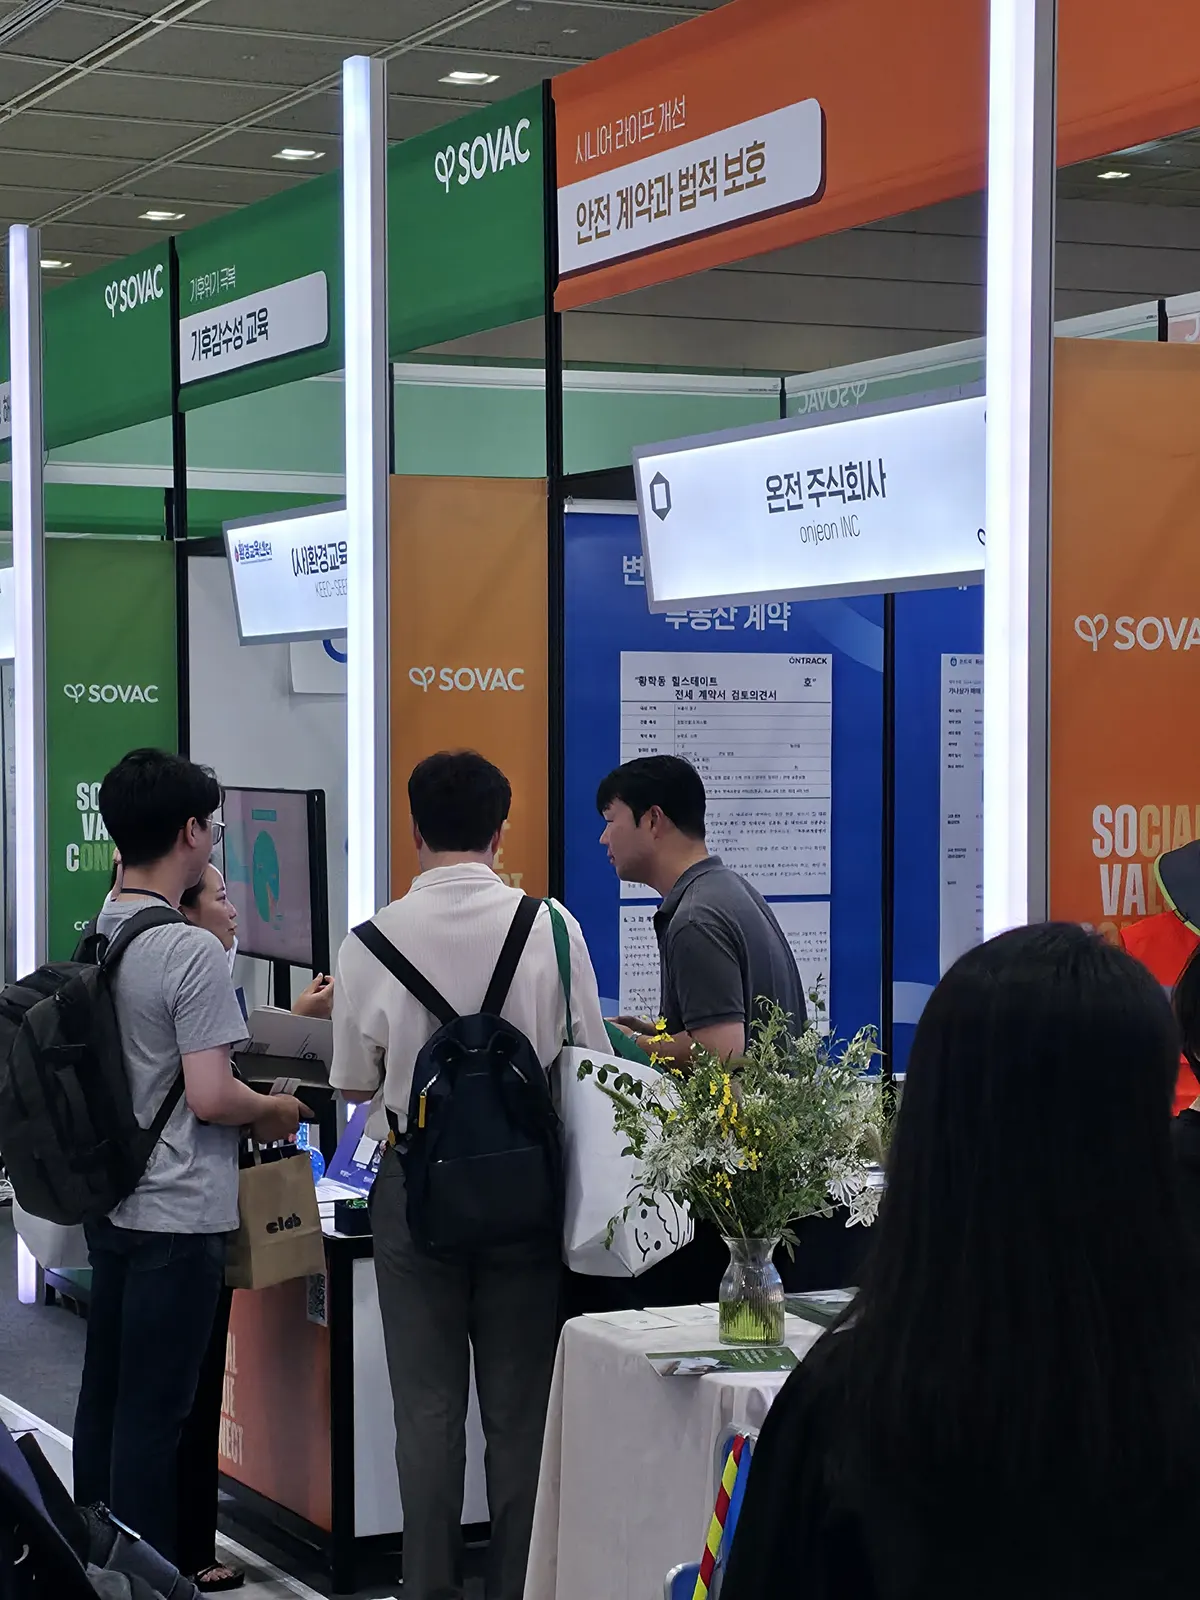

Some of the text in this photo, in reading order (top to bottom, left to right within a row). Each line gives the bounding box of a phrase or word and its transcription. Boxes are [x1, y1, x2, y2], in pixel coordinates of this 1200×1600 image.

[574, 94, 687, 163] 시니어 라이프 개선
[458, 118, 531, 186] SOVAC
[576, 139, 767, 246] 안전 계약과 법적 보호
[119, 263, 164, 312] SOVAC
[190, 265, 236, 302] 기후위기 극복
[190, 307, 269, 362] 기후감수성 교육
[766, 458, 887, 514] 온전 주식회사
[799, 514, 861, 546] onjeon INC
[622, 555, 645, 586] 변
[743, 601, 792, 631] 계약
[789, 657, 828, 665] ONTRACK
[88, 684, 159, 703] SOVAC
[438, 667, 525, 691] SOVAC
[675, 690, 777, 701] 전세 계약서 검토의견서
